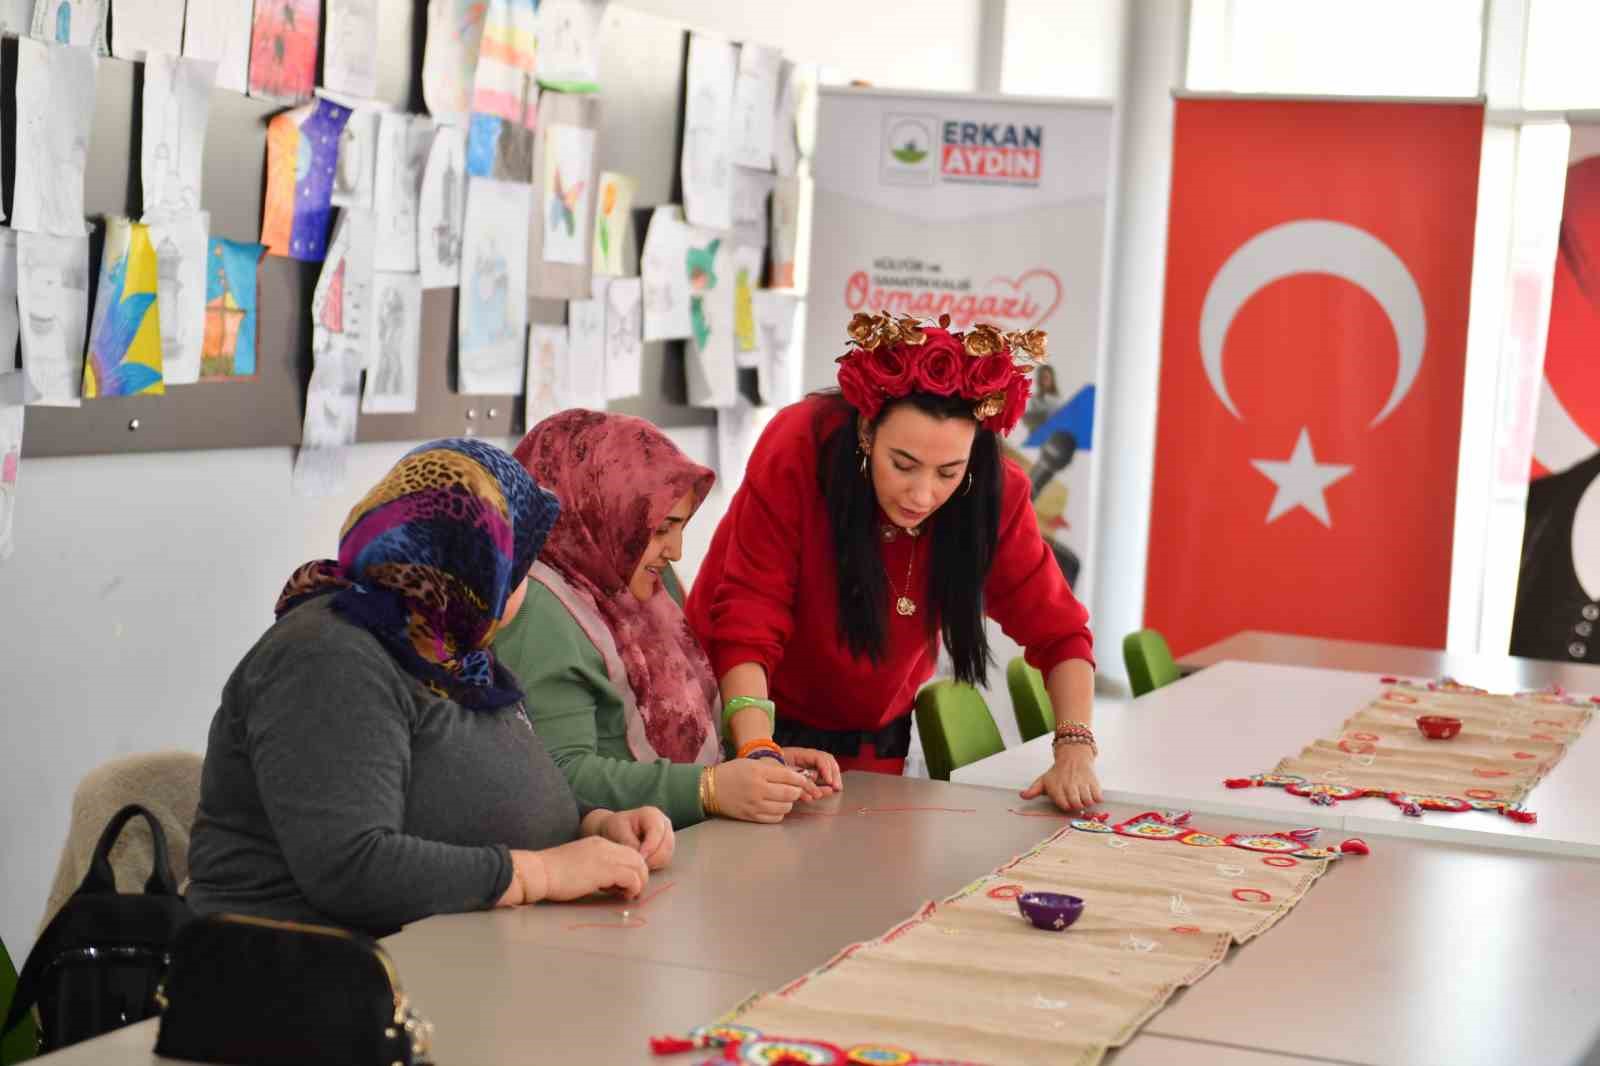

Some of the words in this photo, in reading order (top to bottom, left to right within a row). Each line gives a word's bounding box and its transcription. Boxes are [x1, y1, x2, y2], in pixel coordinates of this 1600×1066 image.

[943, 121, 1042, 147] ERKAN
[944, 147, 1038, 178] AYDIN
[845, 270, 1036, 328] Osmangazi
